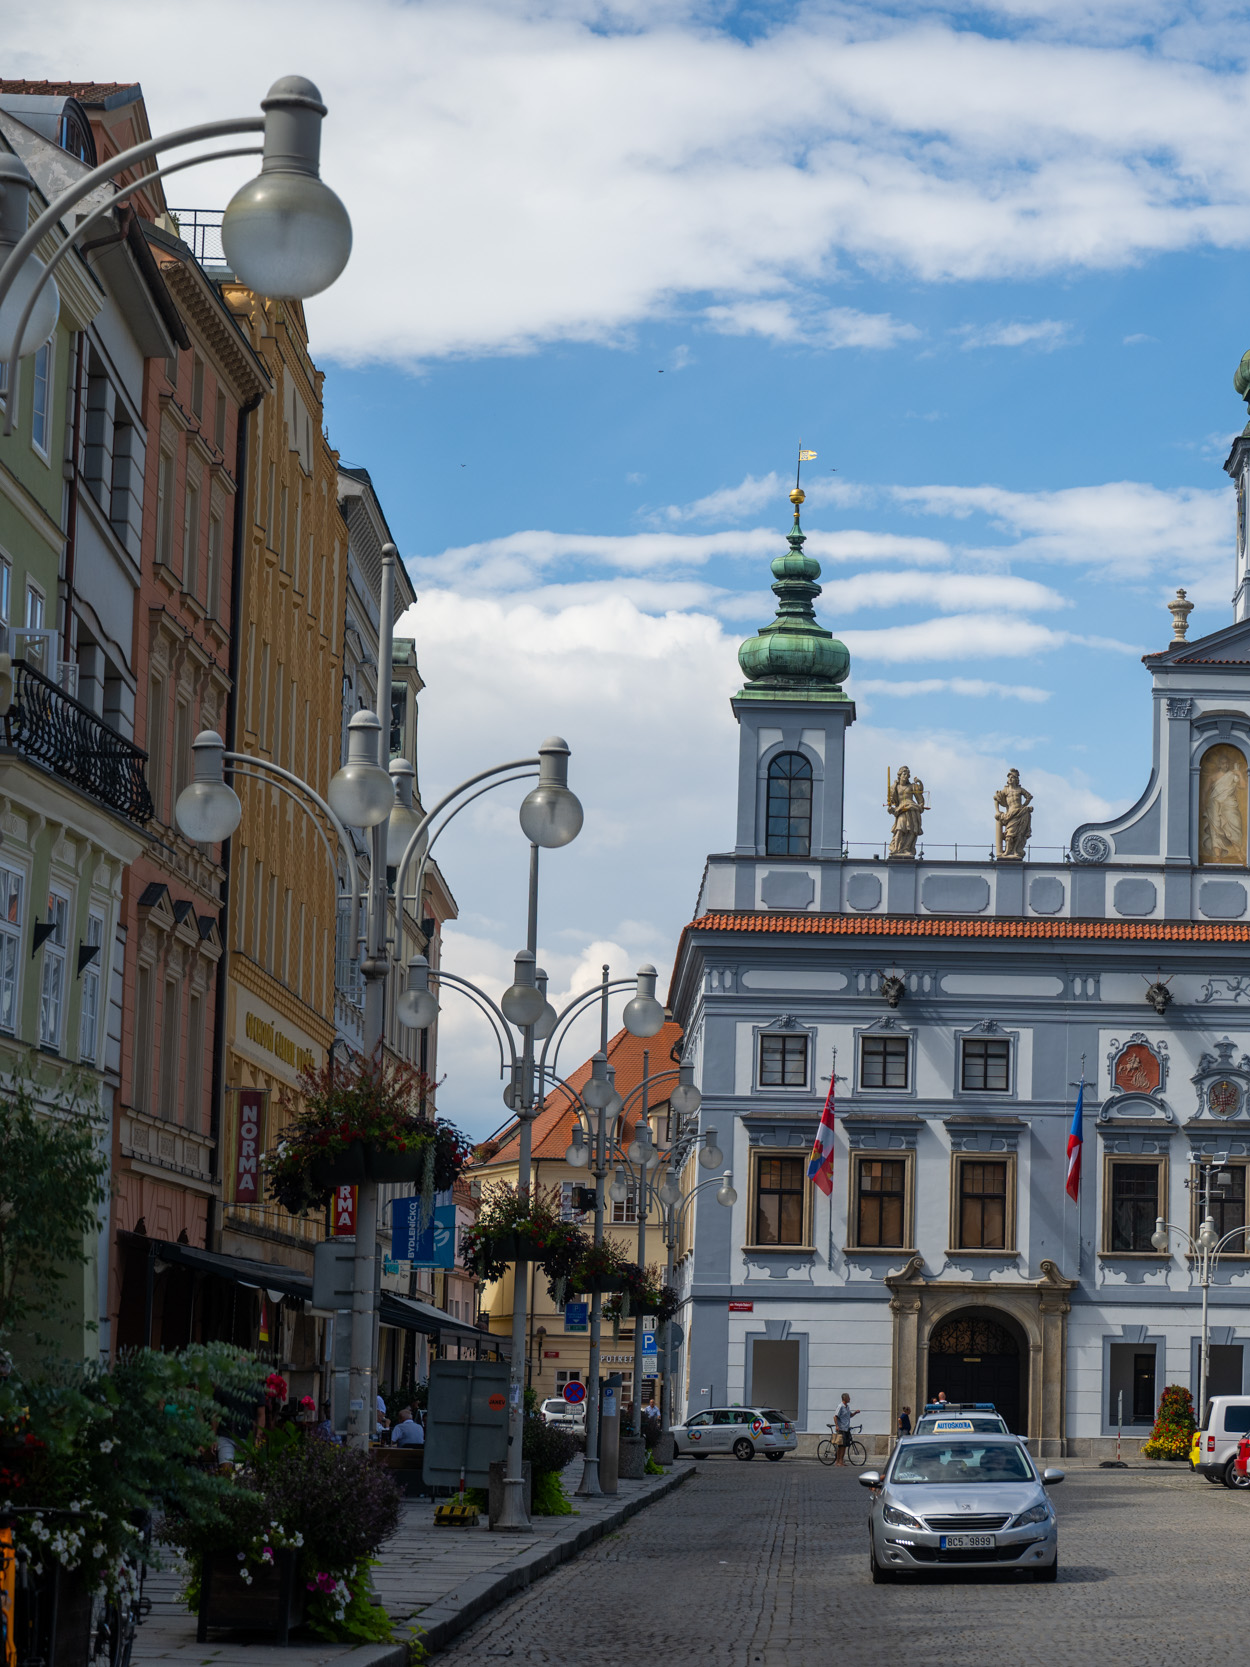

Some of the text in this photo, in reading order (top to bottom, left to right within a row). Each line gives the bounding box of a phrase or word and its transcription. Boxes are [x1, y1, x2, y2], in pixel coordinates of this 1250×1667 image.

[239, 1105, 258, 1190] NORMA
[644, 1334, 655, 1349] P
[947, 1536, 991, 1547] 8C5 9899
